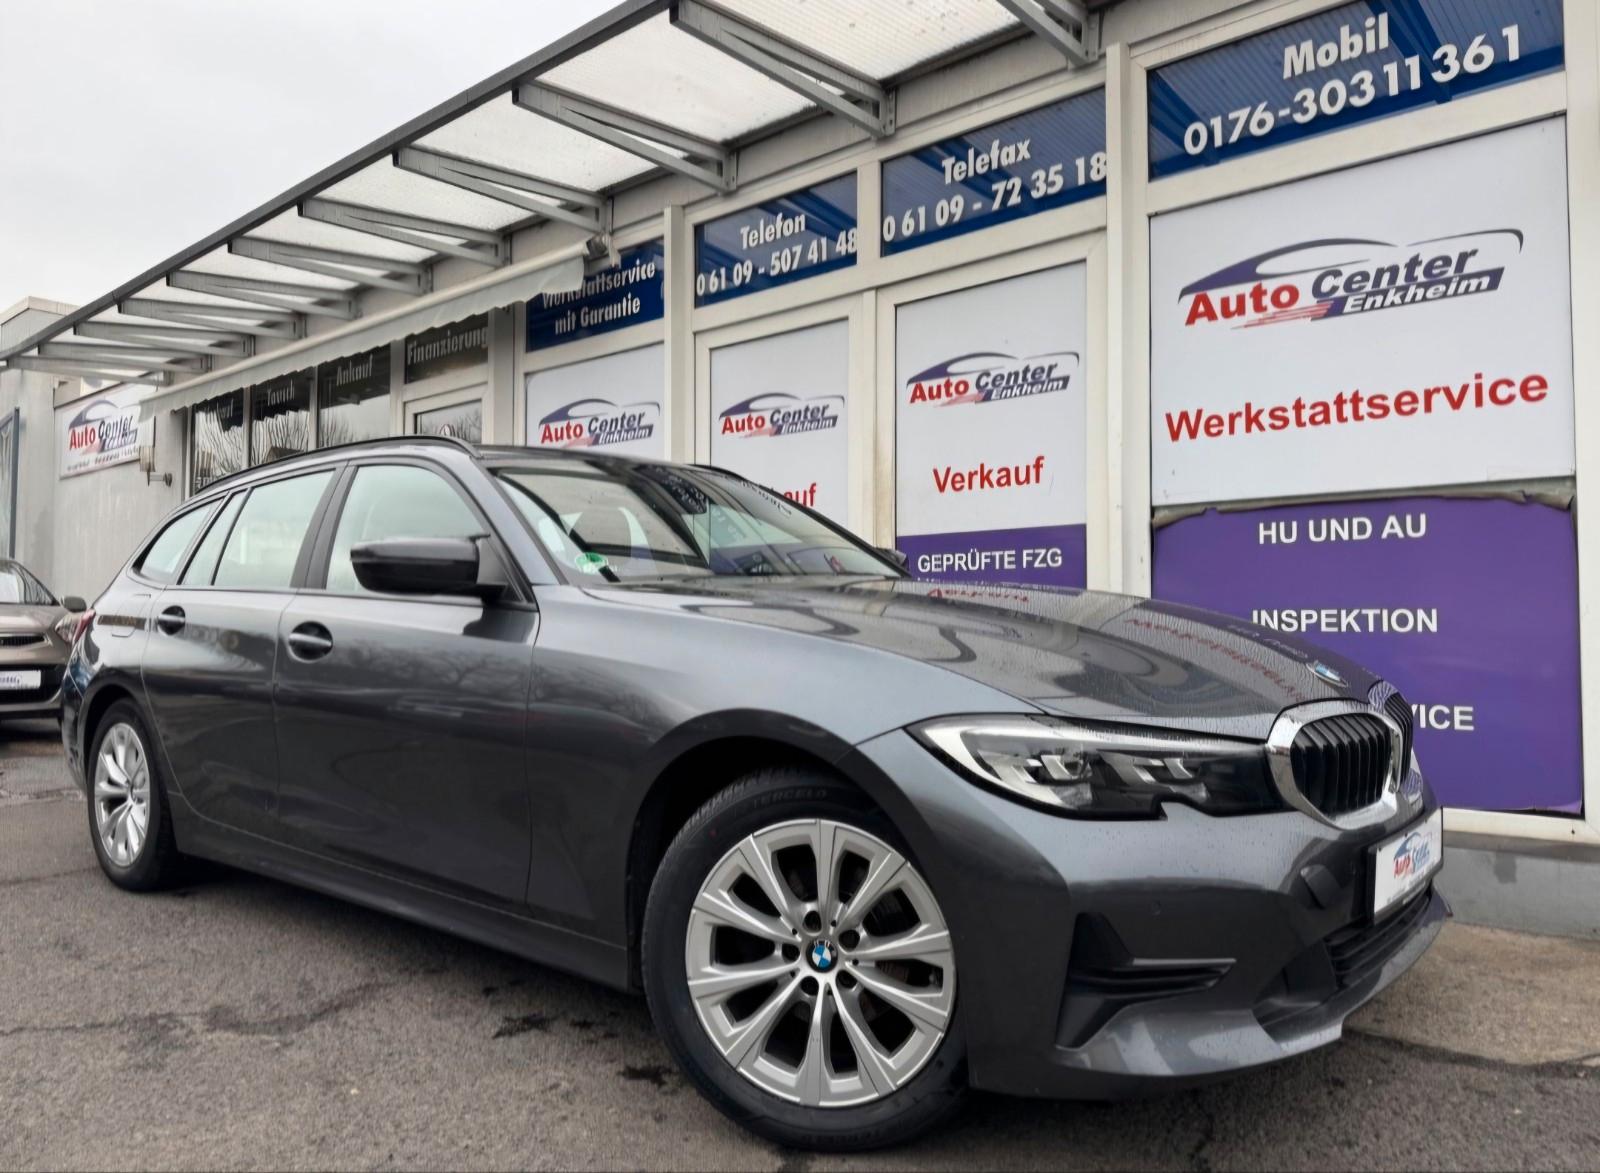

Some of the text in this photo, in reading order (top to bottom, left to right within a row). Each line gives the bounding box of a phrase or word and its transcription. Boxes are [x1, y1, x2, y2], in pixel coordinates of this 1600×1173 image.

[1283, 12, 1389, 79] Mobil
[941, 138, 1031, 185] Telefax
[882, 215, 896, 242] 0
[902, 206, 926, 237] 61
[935, 194, 964, 227] 09
[991, 176, 1022, 212] 72
[1031, 163, 1064, 199] 35
[1075, 152, 1107, 186] 18
[740, 212, 806, 249] Telefon
[733, 259, 753, 286] 09
[770, 245, 803, 277] 507
[807, 236, 828, 264] 41
[835, 227, 858, 256] 48
[1184, 249, 1479, 326] Auto Center
[1342, 272, 1492, 315] Enkheim
[554, 292, 641, 335] mit Garantie
[909, 362, 1058, 404] Auto Center
[989, 378, 1064, 401] Enkheim
[540, 411, 646, 444] Auto Center
[721, 404, 830, 435] Auto Center
[1165, 372, 1549, 443] Werkstattservice
[69, 425, 96, 450] Auto
[932, 455, 1046, 494] Verkauf
[1258, 512, 1428, 545] HU UND AU
[916, 547, 1063, 573] GEPRÜFTE FZG
[1252, 607, 1438, 633] INSPEKTION
